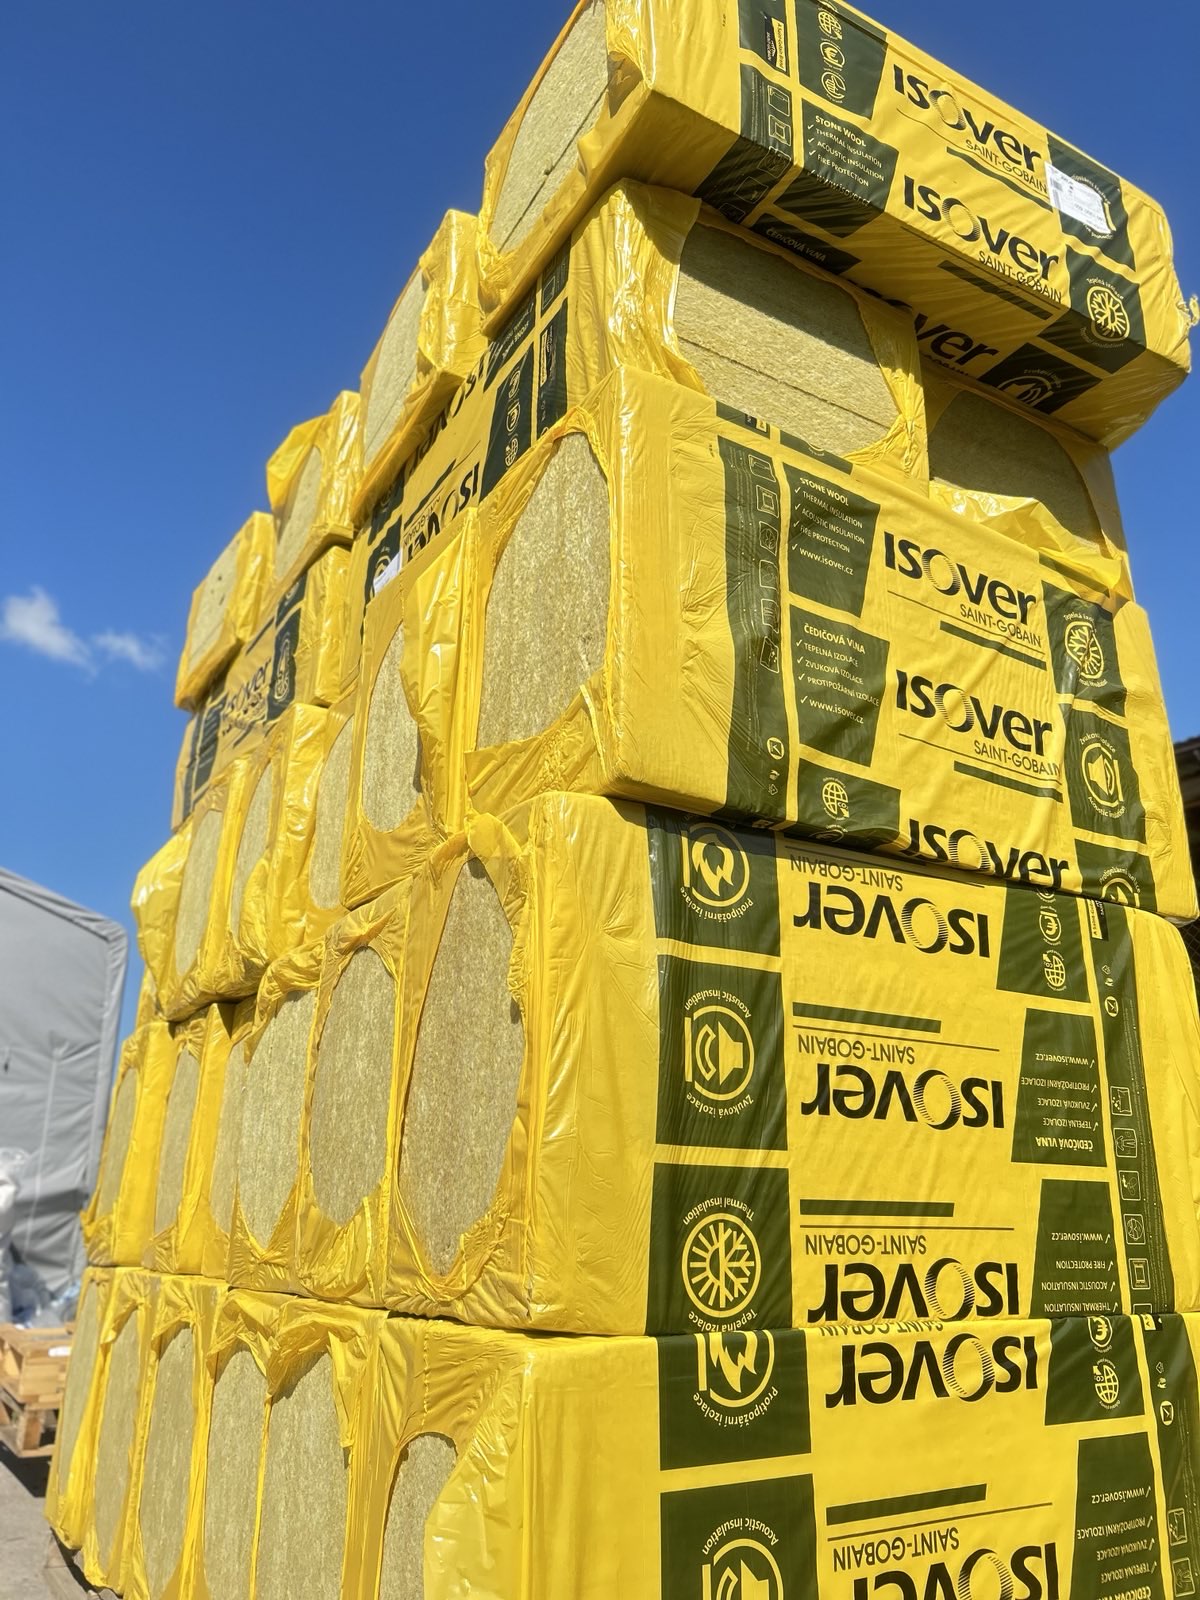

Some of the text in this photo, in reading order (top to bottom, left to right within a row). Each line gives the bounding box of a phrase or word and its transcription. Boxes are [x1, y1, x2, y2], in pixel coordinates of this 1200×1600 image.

[815, 115, 867, 147] STONE WOOL
[815, 128, 882, 169] THERMAL INSULATION
[817, 141, 884, 182] ACOUSTIC INSULATION
[817, 154, 869, 187] FIRE PROTECTION
[965, 139, 1048, 194] SAINT-GOBAIN
[978, 250, 1062, 304] SAINT-GOBAIN
[800, 477, 849, 506] STONE WOOL
[803, 490, 863, 529] THERMAL INSULATION
[801, 508, 865, 545] ACOUSTIC INSULATION
[801, 525, 850, 553] FIRE PROTECTION
[799, 547, 854, 576] www.isover.cz
[803, 622, 866, 654] ČEDIČOVÁ VLNA
[959, 603, 1042, 649] SAINT-GOBAIN
[803, 642, 859, 668] TEPELNÁ IZOLACE
[805, 659, 864, 685] ZVUKOVÁ IZOLACE
[807, 676, 880, 707] PROTIPOŽÁRNÍ IZOLACE
[809, 698, 865, 724] www.isover.cz
[973, 740, 1062, 777] SAINT-GOBAIN
[790, 854, 904, 892] SAINT-GOBAIN
[680, 886, 754, 923] Protipožární izolace
[684, 989, 752, 1018] Acoustic insulation
[798, 1033, 915, 1065] SAINT-GOBAIN
[1035, 1053, 1089, 1065] www.isover.cz
[1021, 1076, 1090, 1092] PROTIPOŽÁRNÍ IZOLACE
[686, 1091, 754, 1119] Zvuková izolace
[1037, 1097, 1091, 1110] ZVUKOVÁ IZOLACE
[1042, 1117, 1092, 1130] TEPELNÁ IZOLACE
[1035, 1136, 1094, 1152] ČEDIČOVÁ VLNA
[682, 1197, 755, 1225] Thermal insulation
[805, 1234, 926, 1255] SAINT-GOBAIN
[1051, 1232, 1103, 1243] www.isover.cz
[1055, 1260, 1106, 1270] FIRE PROTECTION
[1041, 1281, 1108, 1291] ACOUSTIC INSULATION
[688, 1310, 719, 1332] izolace
[1044, 1302, 1111, 1313] THERMAL INSULATION
[693, 1386, 779, 1427] Protipožární izolace
[1092, 1487, 1145, 1504] www.isover.cz
[701, 1517, 779, 1555] Acoustic insulation
[1076, 1525, 1105, 1540] IZOLACE
[833, 1527, 960, 1572] SAINT-GOBAIN
[1096, 1545, 1121, 1561] IZOLACE
[1101, 1568, 1125, 1584] IZOLACE
